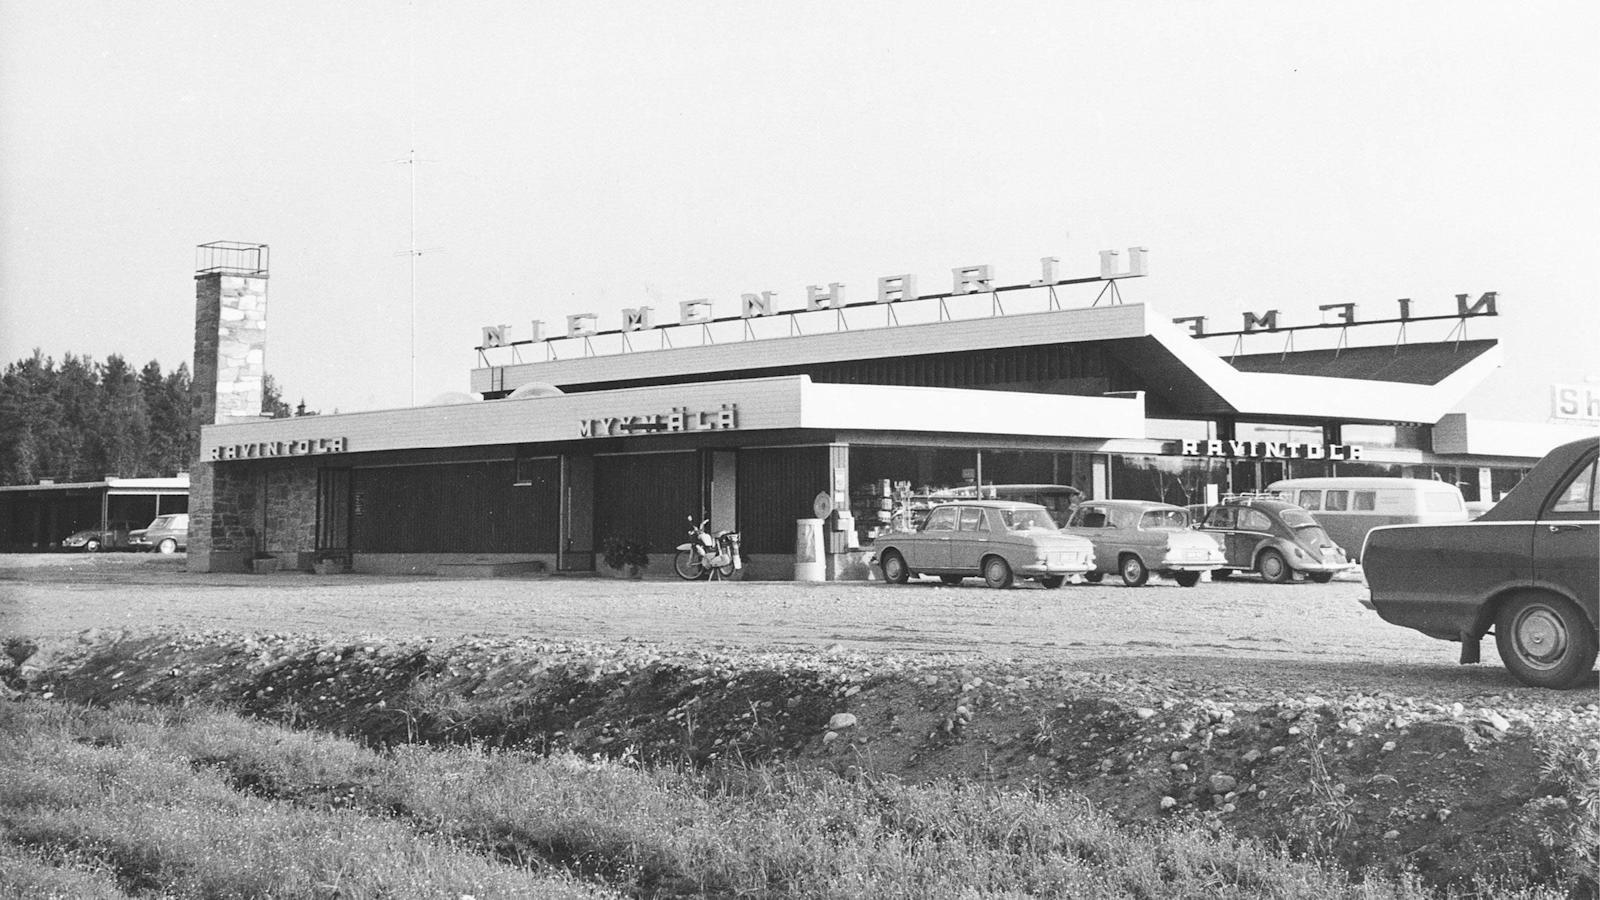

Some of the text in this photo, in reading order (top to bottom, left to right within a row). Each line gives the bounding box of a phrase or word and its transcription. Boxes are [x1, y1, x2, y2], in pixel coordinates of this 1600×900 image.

[481, 246, 1149, 348] NIEMENHARJU
[578, 403, 739, 437] MYYMÄLÄ
[208, 436, 348, 461] RAVINTOLA
[1182, 439, 1364, 460] RAVINTOLA
